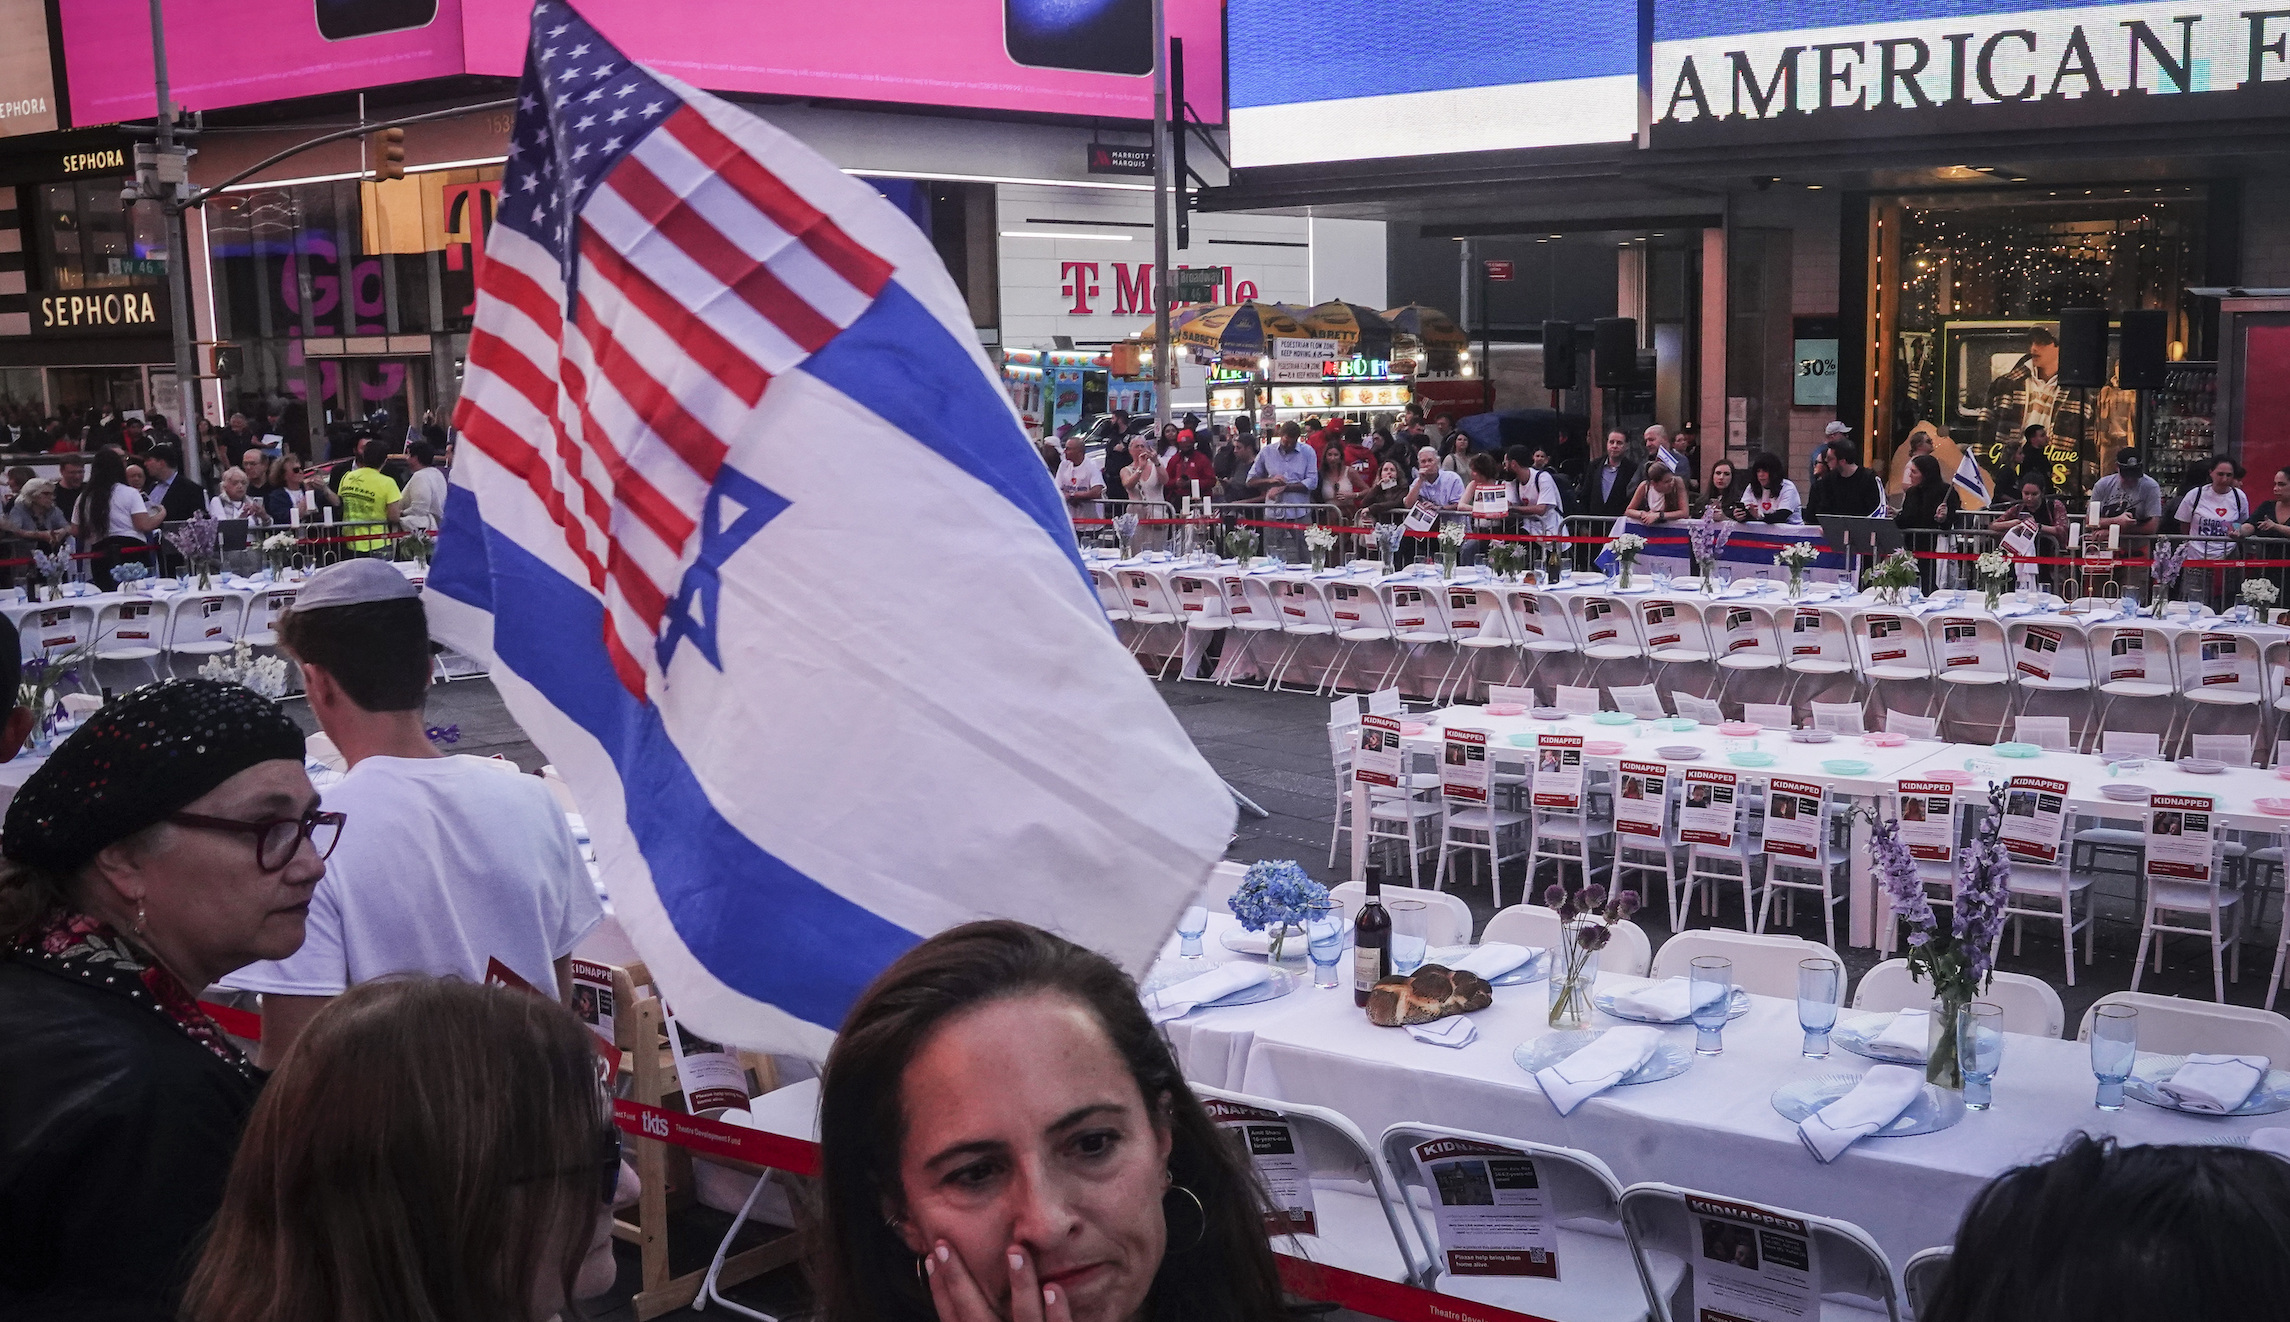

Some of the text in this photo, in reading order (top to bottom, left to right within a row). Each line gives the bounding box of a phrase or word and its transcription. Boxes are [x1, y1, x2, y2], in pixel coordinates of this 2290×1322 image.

[1663, 15, 2202, 121] AMERICAN
[0, 97, 47, 119] EPHORA
[63, 149, 124, 173] SEPHORA
[1112, 151, 1150, 160] MARRIOTT
[1112, 159, 1146, 168] MARQUIS
[139, 260, 154, 274] 46
[1180, 270, 1220, 283] Broadway
[1112, 262, 1259, 315] Mle
[42, 292, 156, 328] SEPHORA
[1182, 331, 1219, 347] SABRETT
[1309, 330, 1357, 341] ABRETT
[1281, 340, 1335, 350] PEDESTRIAN FLOW ZONE
[1281, 349, 1292, 357] KEEP
[1278, 362, 1303, 370] PEDESTRIAN
[1363, 716, 1400, 729] KIDNAPPED
[1446, 729, 1484, 742] KIDNAPPED
[1540, 736, 1582, 745] KIDNAPPED
[1622, 762, 1665, 773] KIDNAPPED
[1687, 770, 1735, 782] KIDNAPPED
[1773, 780, 1820, 795] KIDNAPPED
[1901, 782, 1951, 792] KIDNAPPED
[2013, 777, 2065, 791] KIDNAPPED
[2153, 797, 2210, 809] KIDNAPPED
[572, 963, 613, 982] IDNAPPE
[695, 1092, 713, 1100] Please
[1206, 1104, 1278, 1118] DNAPPED
[641, 1110, 669, 1137] tkts
[676, 1123, 694, 1134] Theatre
[694, 1127, 727, 1143] Development
[728, 1135, 741, 1146] Fund
[1691, 1200, 1800, 1231] KIDNAPPED
[1489, 1254, 1505, 1262] bring
[1429, 1305, 1460, 1321] Theatre
